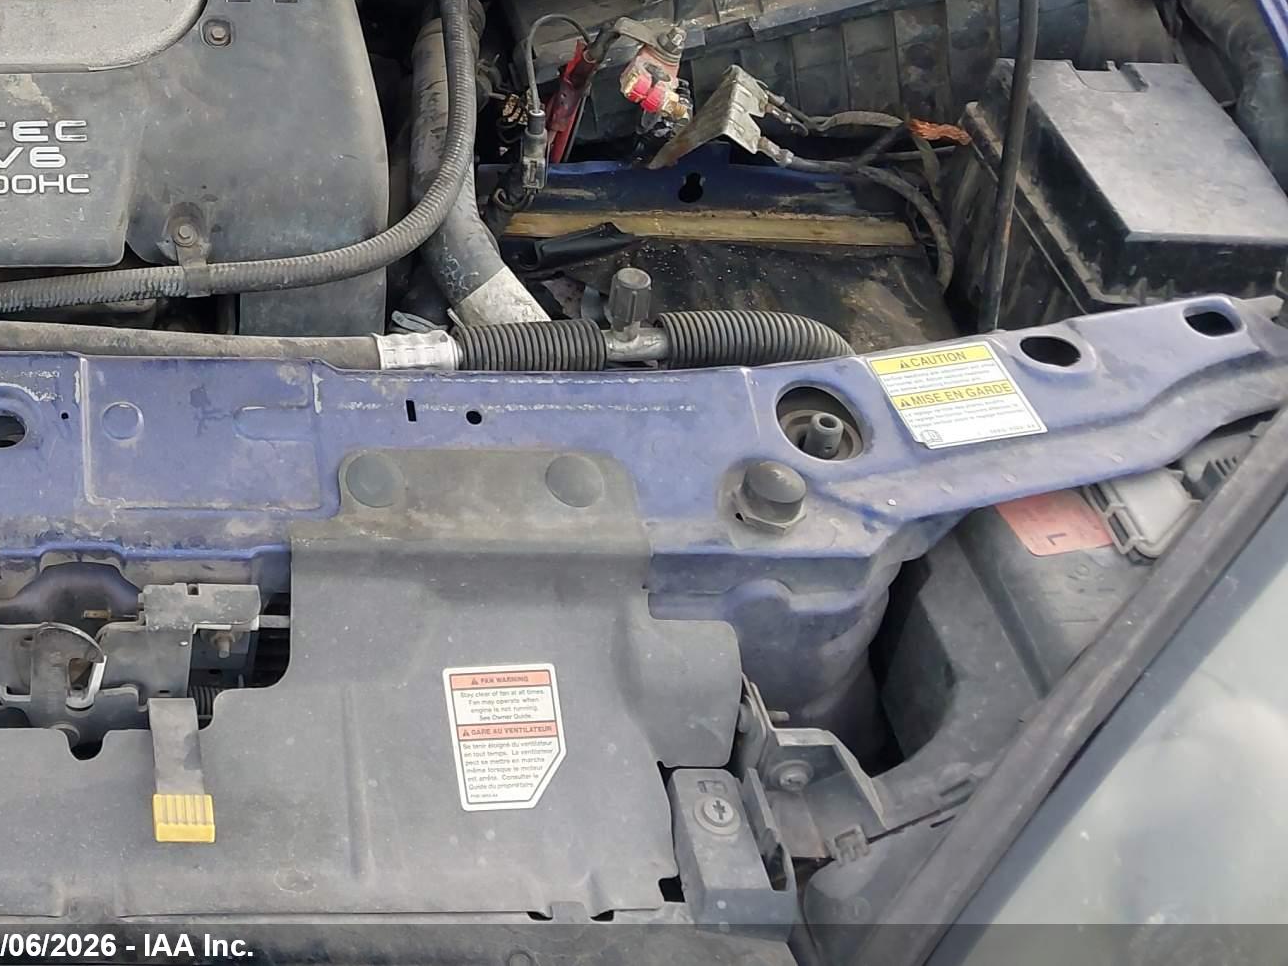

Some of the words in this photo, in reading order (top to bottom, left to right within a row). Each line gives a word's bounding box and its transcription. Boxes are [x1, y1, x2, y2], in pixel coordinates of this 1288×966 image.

[910, 351, 967, 368] CAUTION
[910, 392, 944, 406] MISE
[946, 389, 964, 401] EN
[966, 383, 1012, 398] GARDE
[504, 725, 552, 733] VENTILATEUR
